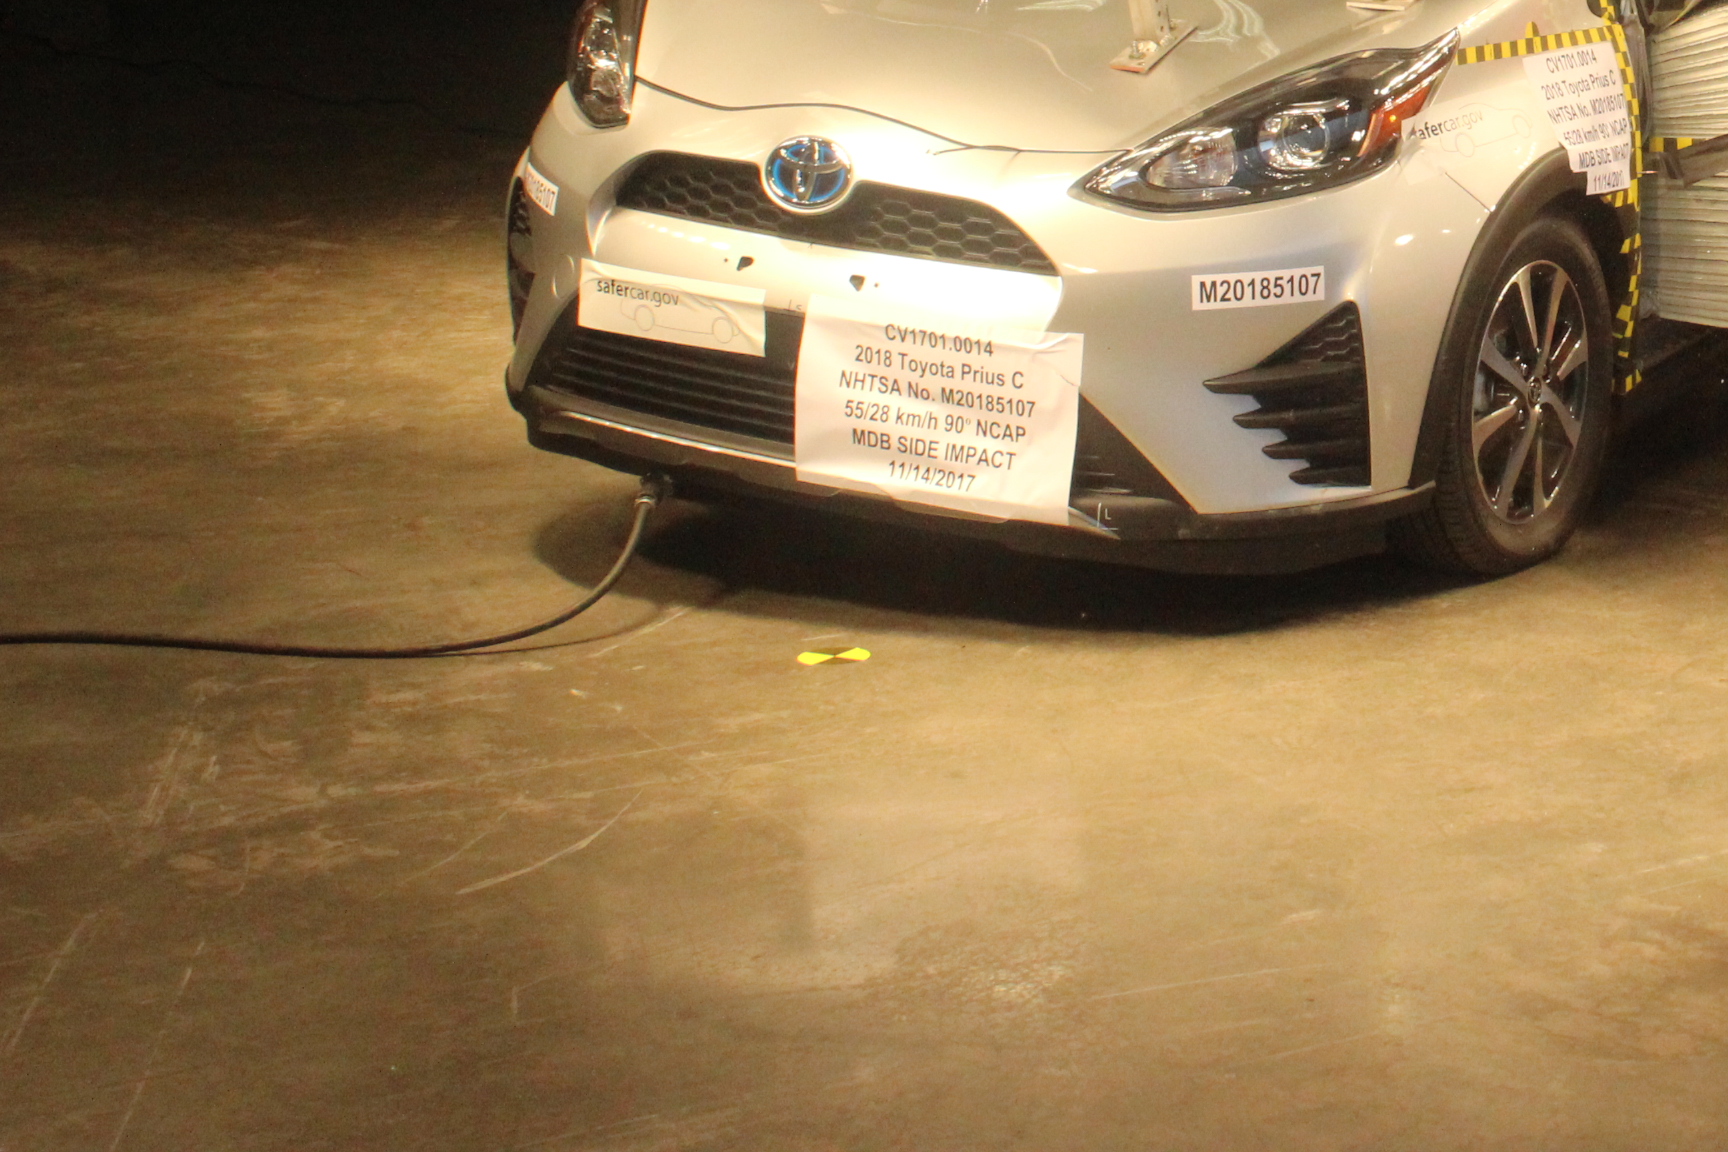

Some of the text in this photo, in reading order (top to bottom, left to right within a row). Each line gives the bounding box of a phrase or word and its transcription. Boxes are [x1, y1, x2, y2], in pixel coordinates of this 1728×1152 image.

[1546, 49, 1597, 74] CV1701.0014
[1541, 69, 1616, 101] 2018 Toyota Prius C
[1547, 104, 1578, 124] NHTSA
[1576, 102, 1591, 117] No.
[1578, 150, 1596, 169] MDB
[597, 279, 679, 308] safercar.gov
[1199, 272, 1321, 304] M20185107
[885, 323, 994, 358] CV1701.0014
[855, 344, 1024, 390] 2018 Toyota Prius C
[839, 370, 1036, 418] NHTSA No. M20185107
[844, 399, 890, 423] 55/28
[895, 408, 938, 431] km/h
[975, 419, 1026, 443] NCAP
[852, 427, 1016, 471] MDB SIDE IMPACT
[888, 460, 976, 493] 11/14/2017
